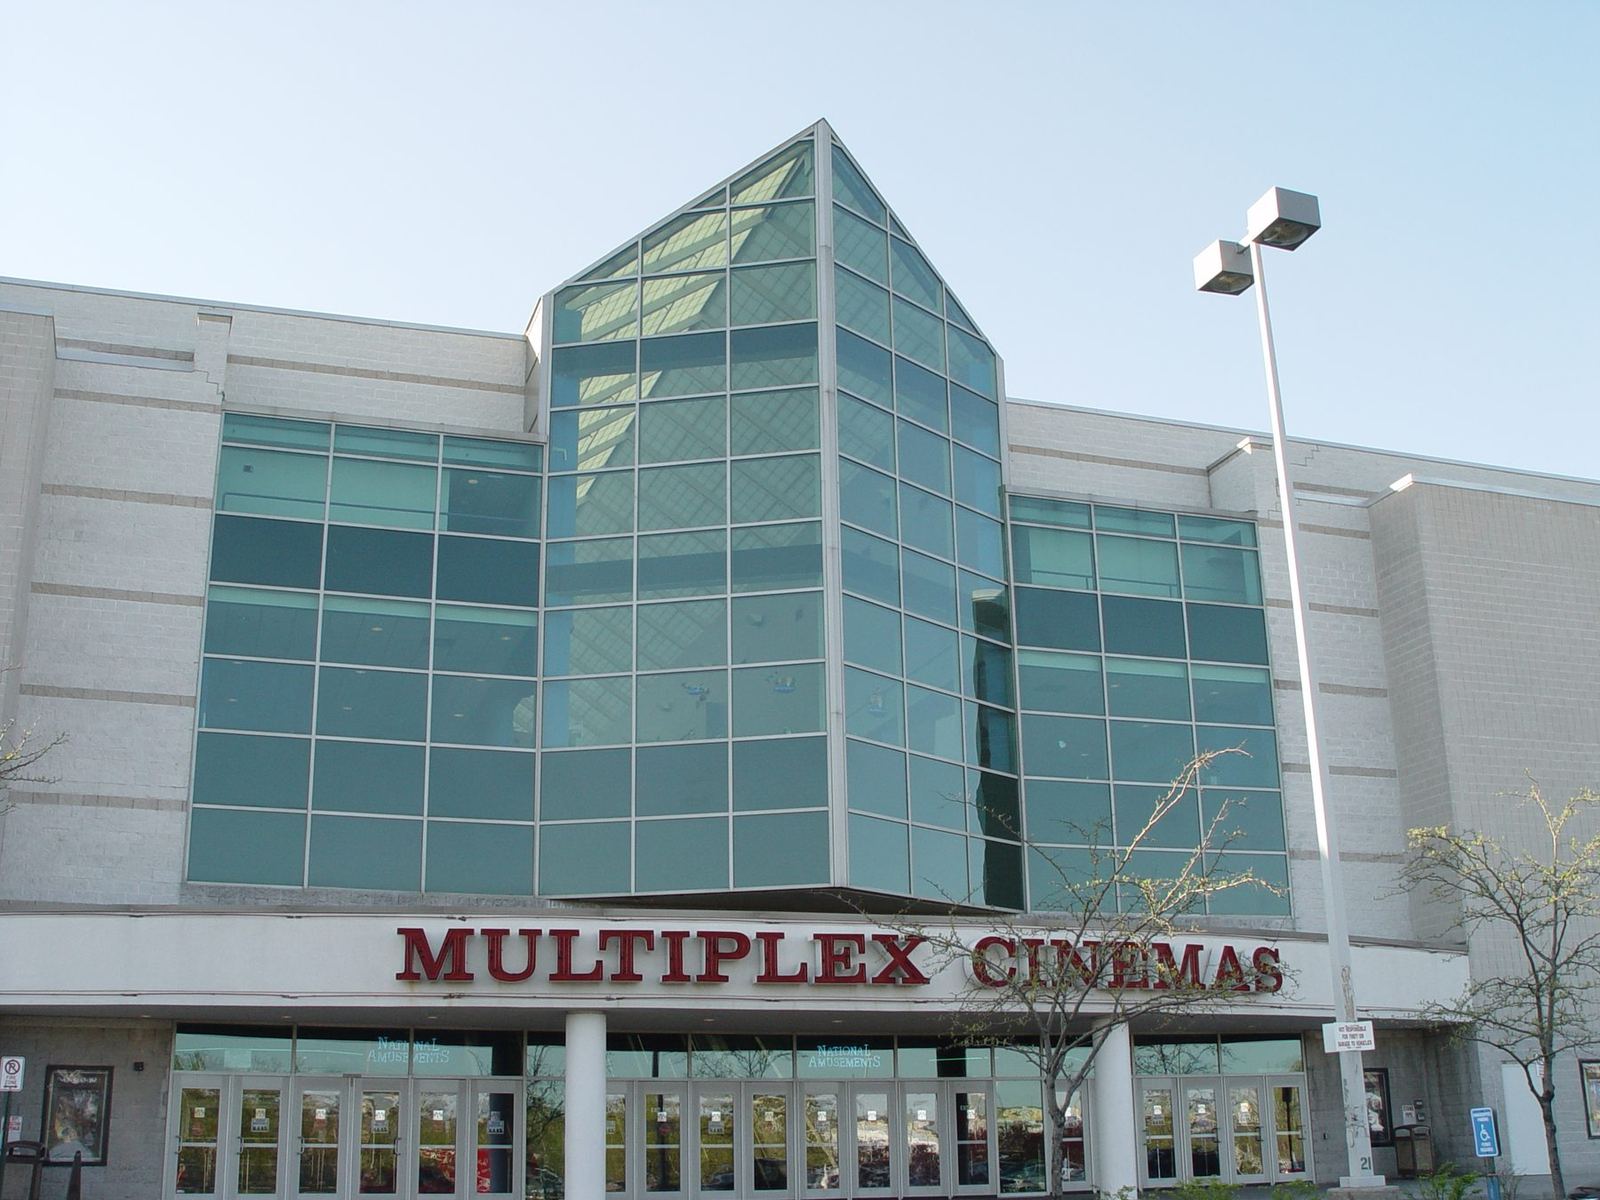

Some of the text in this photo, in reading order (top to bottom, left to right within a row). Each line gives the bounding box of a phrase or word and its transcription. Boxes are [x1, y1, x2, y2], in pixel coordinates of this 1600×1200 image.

[396, 927, 1283, 993] MULTIPLEX CINEMAS
[377, 1036, 440, 1051] NATINAL
[816, 1043, 871, 1057] NATIONAL
[808, 1056, 881, 1068] AMUSEMENTS
[1361, 1157, 1372, 1170] 21
